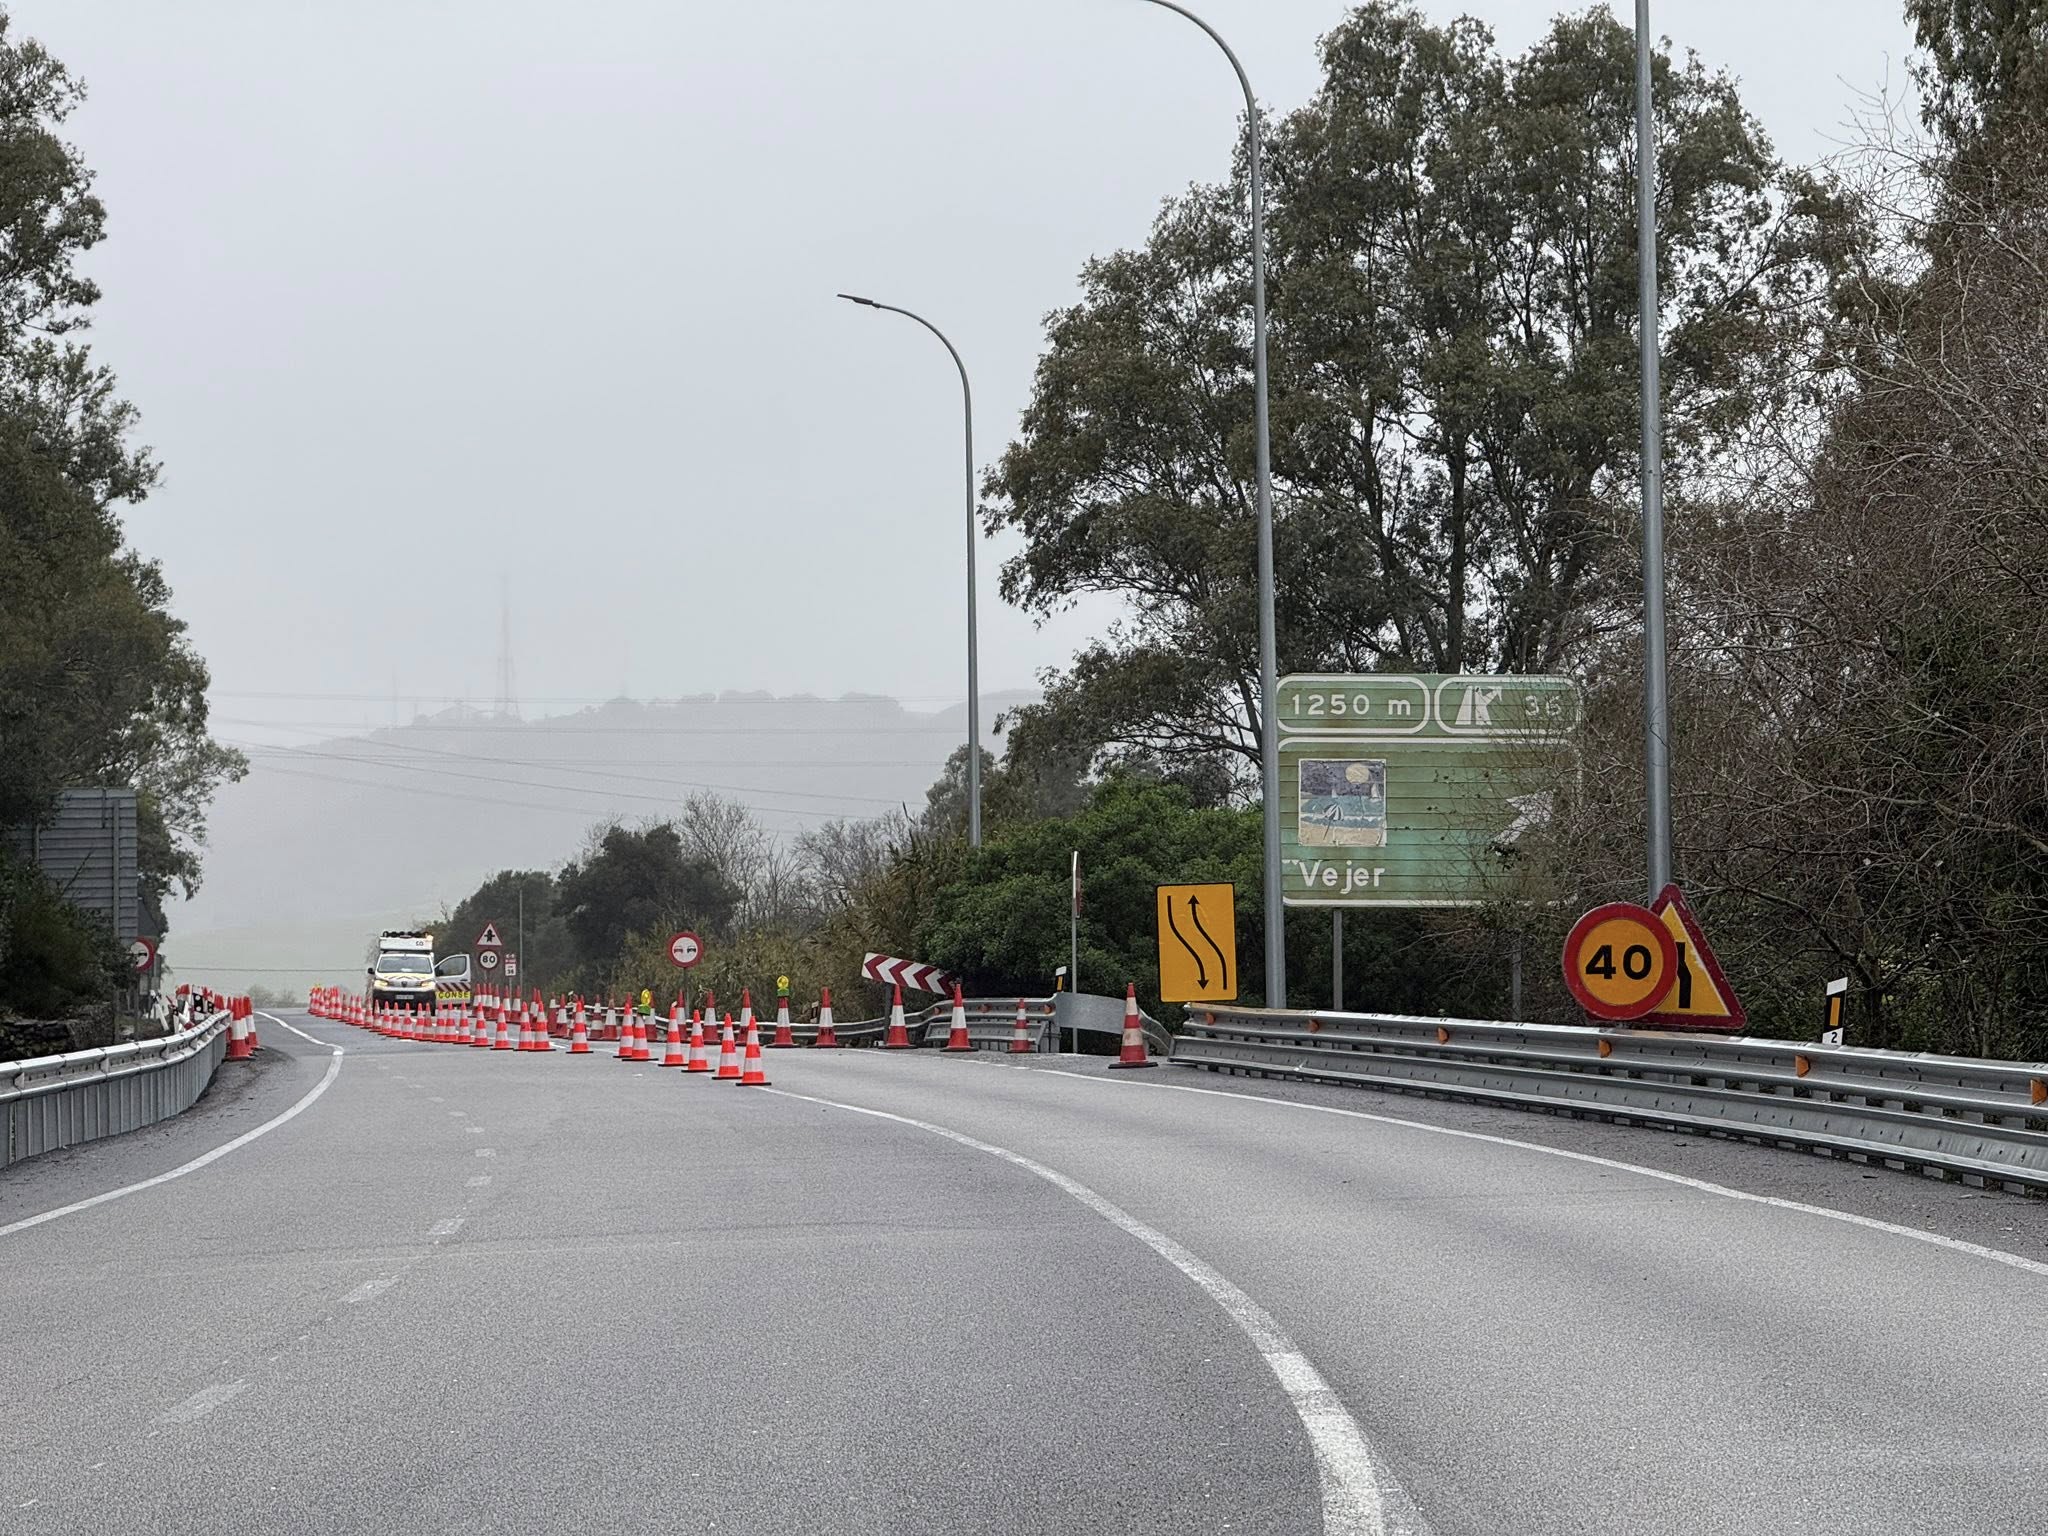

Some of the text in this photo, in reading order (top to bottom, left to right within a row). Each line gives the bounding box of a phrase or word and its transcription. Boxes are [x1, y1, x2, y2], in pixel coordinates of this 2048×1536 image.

[1292, 693, 1411, 716] 1250 m
[1298, 859, 1386, 894] Vejer
[482, 955, 496, 963] 80
[1585, 944, 1652, 980] 40
[438, 991, 469, 999] CONSE
[1831, 1031, 1838, 1043] 2
